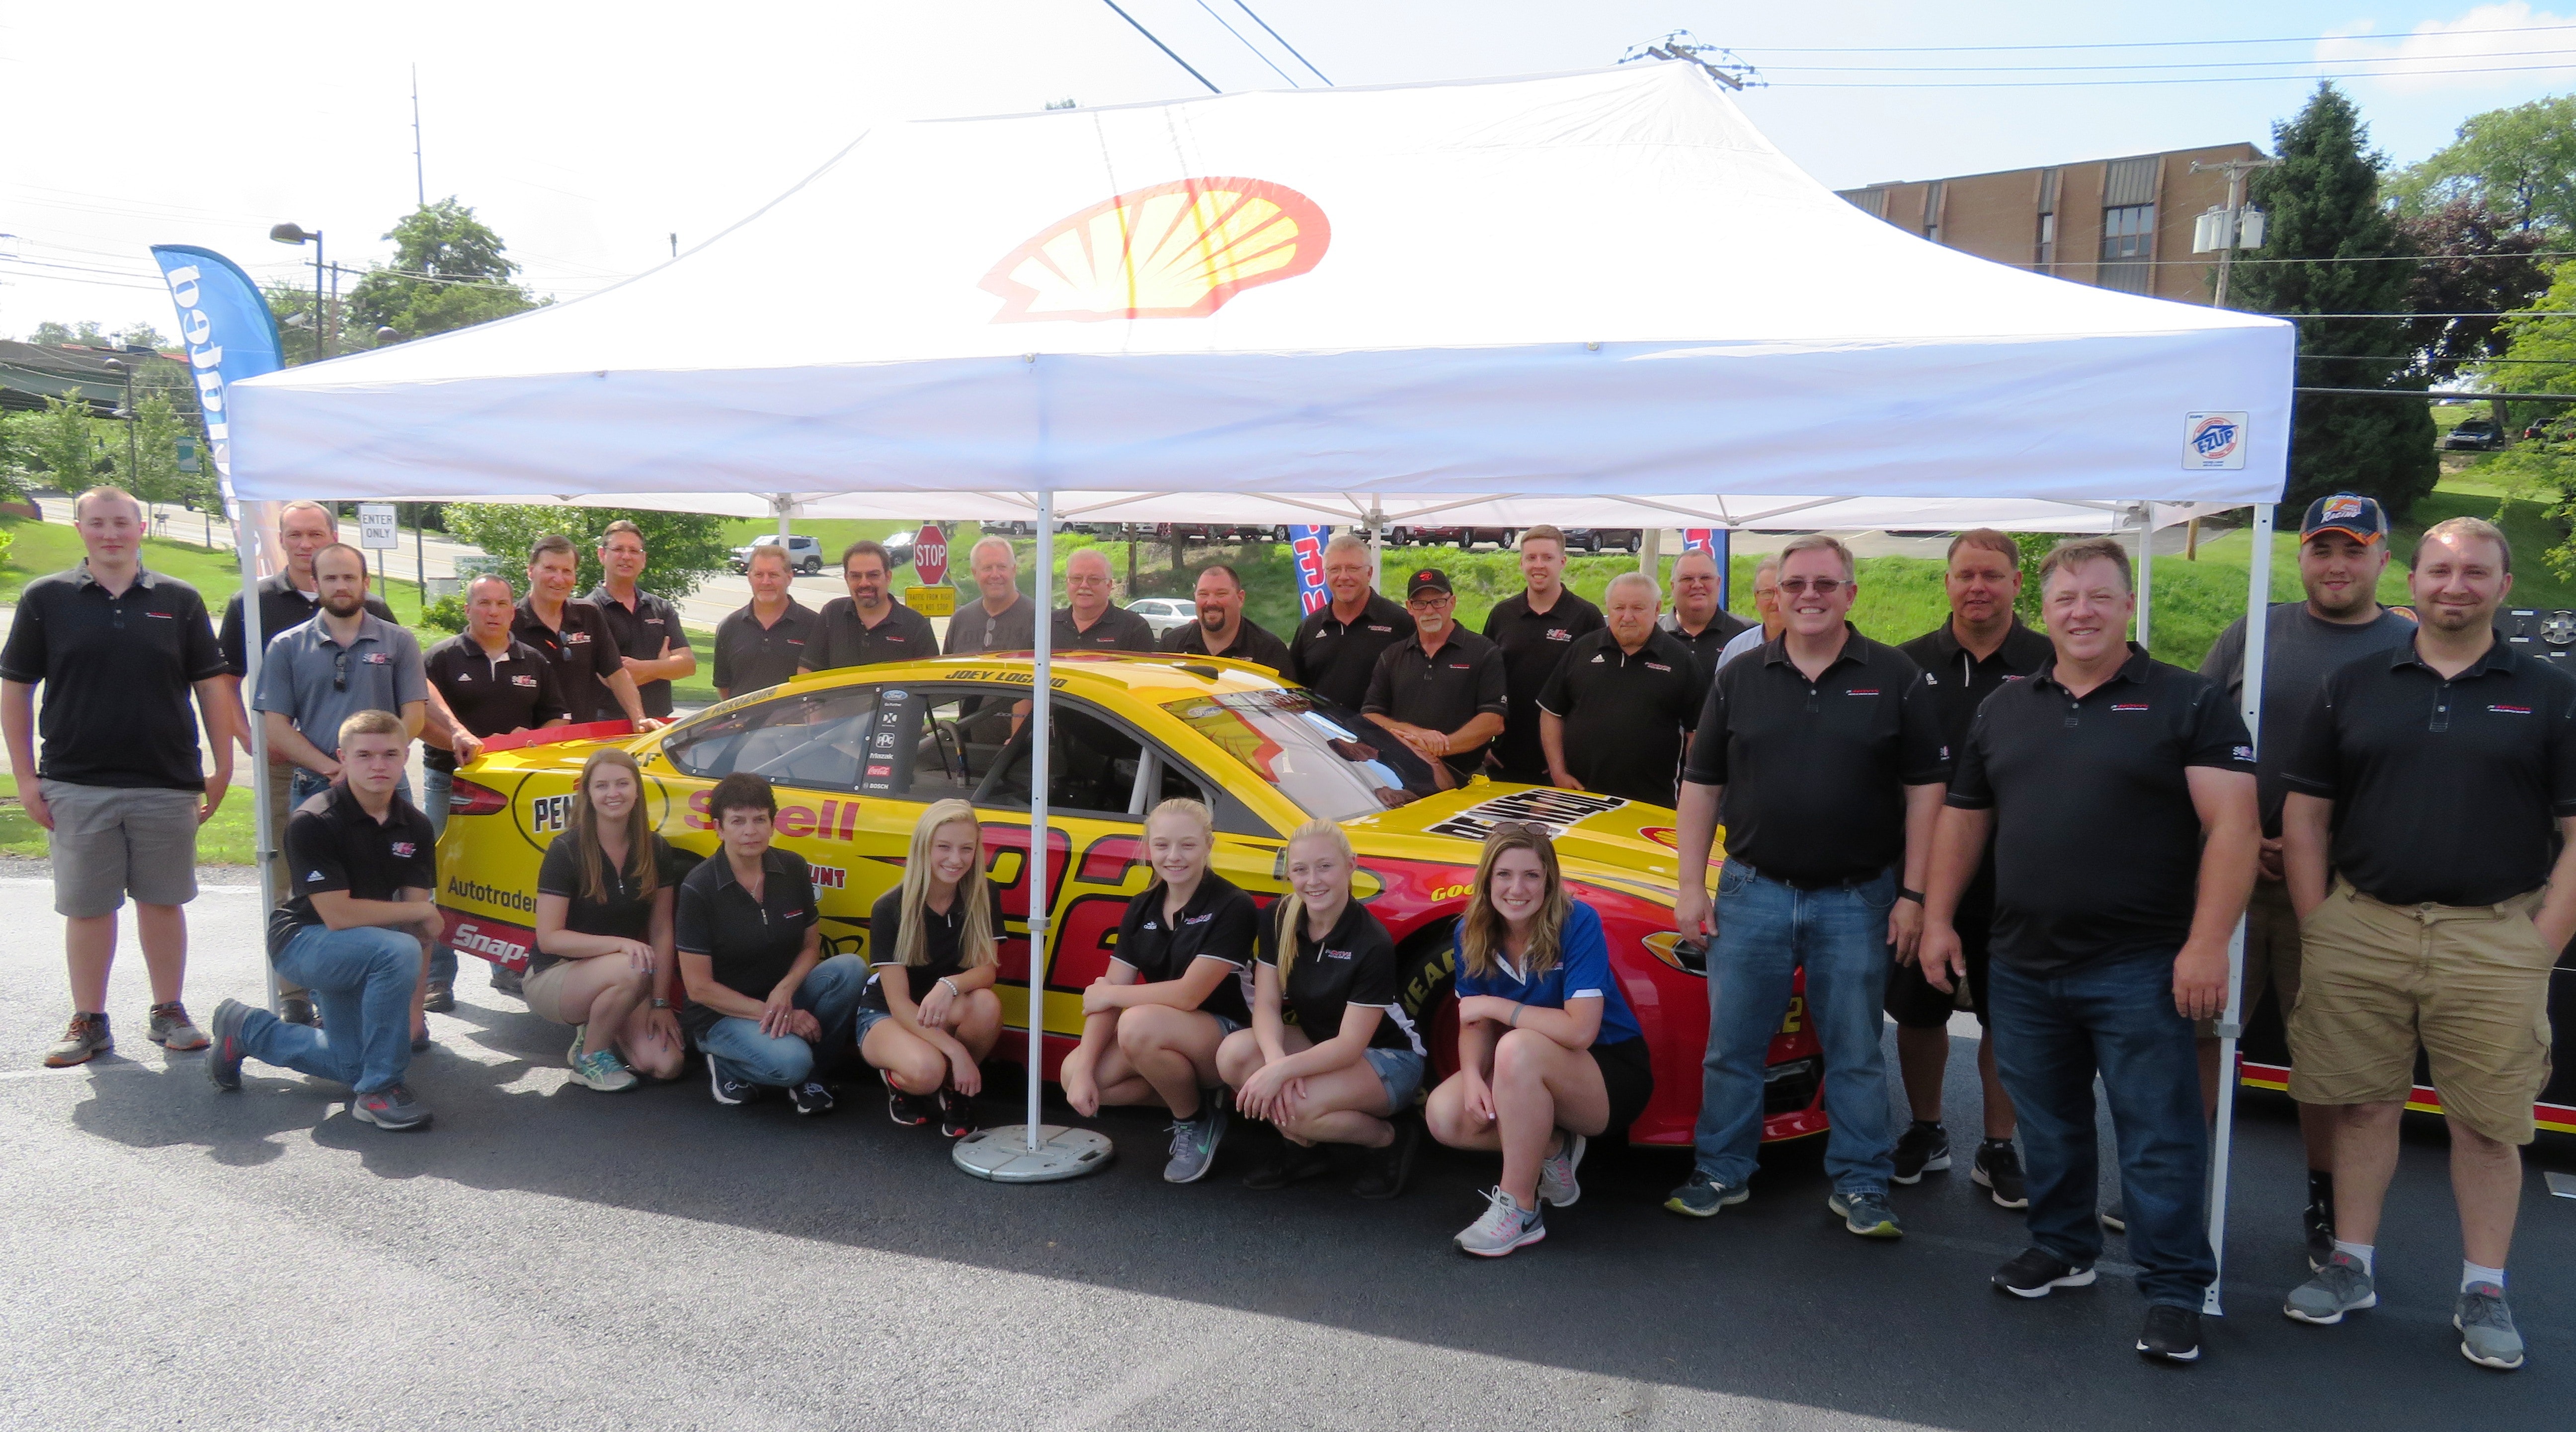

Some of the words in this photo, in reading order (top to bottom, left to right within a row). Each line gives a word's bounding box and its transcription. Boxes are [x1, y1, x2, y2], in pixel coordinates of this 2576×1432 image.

[362, 514, 393, 524] ENTER
[366, 528, 391, 538] ONLY
[916, 545, 946, 566] STOP
[945, 670, 994, 680] JOEY
[877, 734, 893, 746] PPG
[684, 790, 861, 841] Sell
